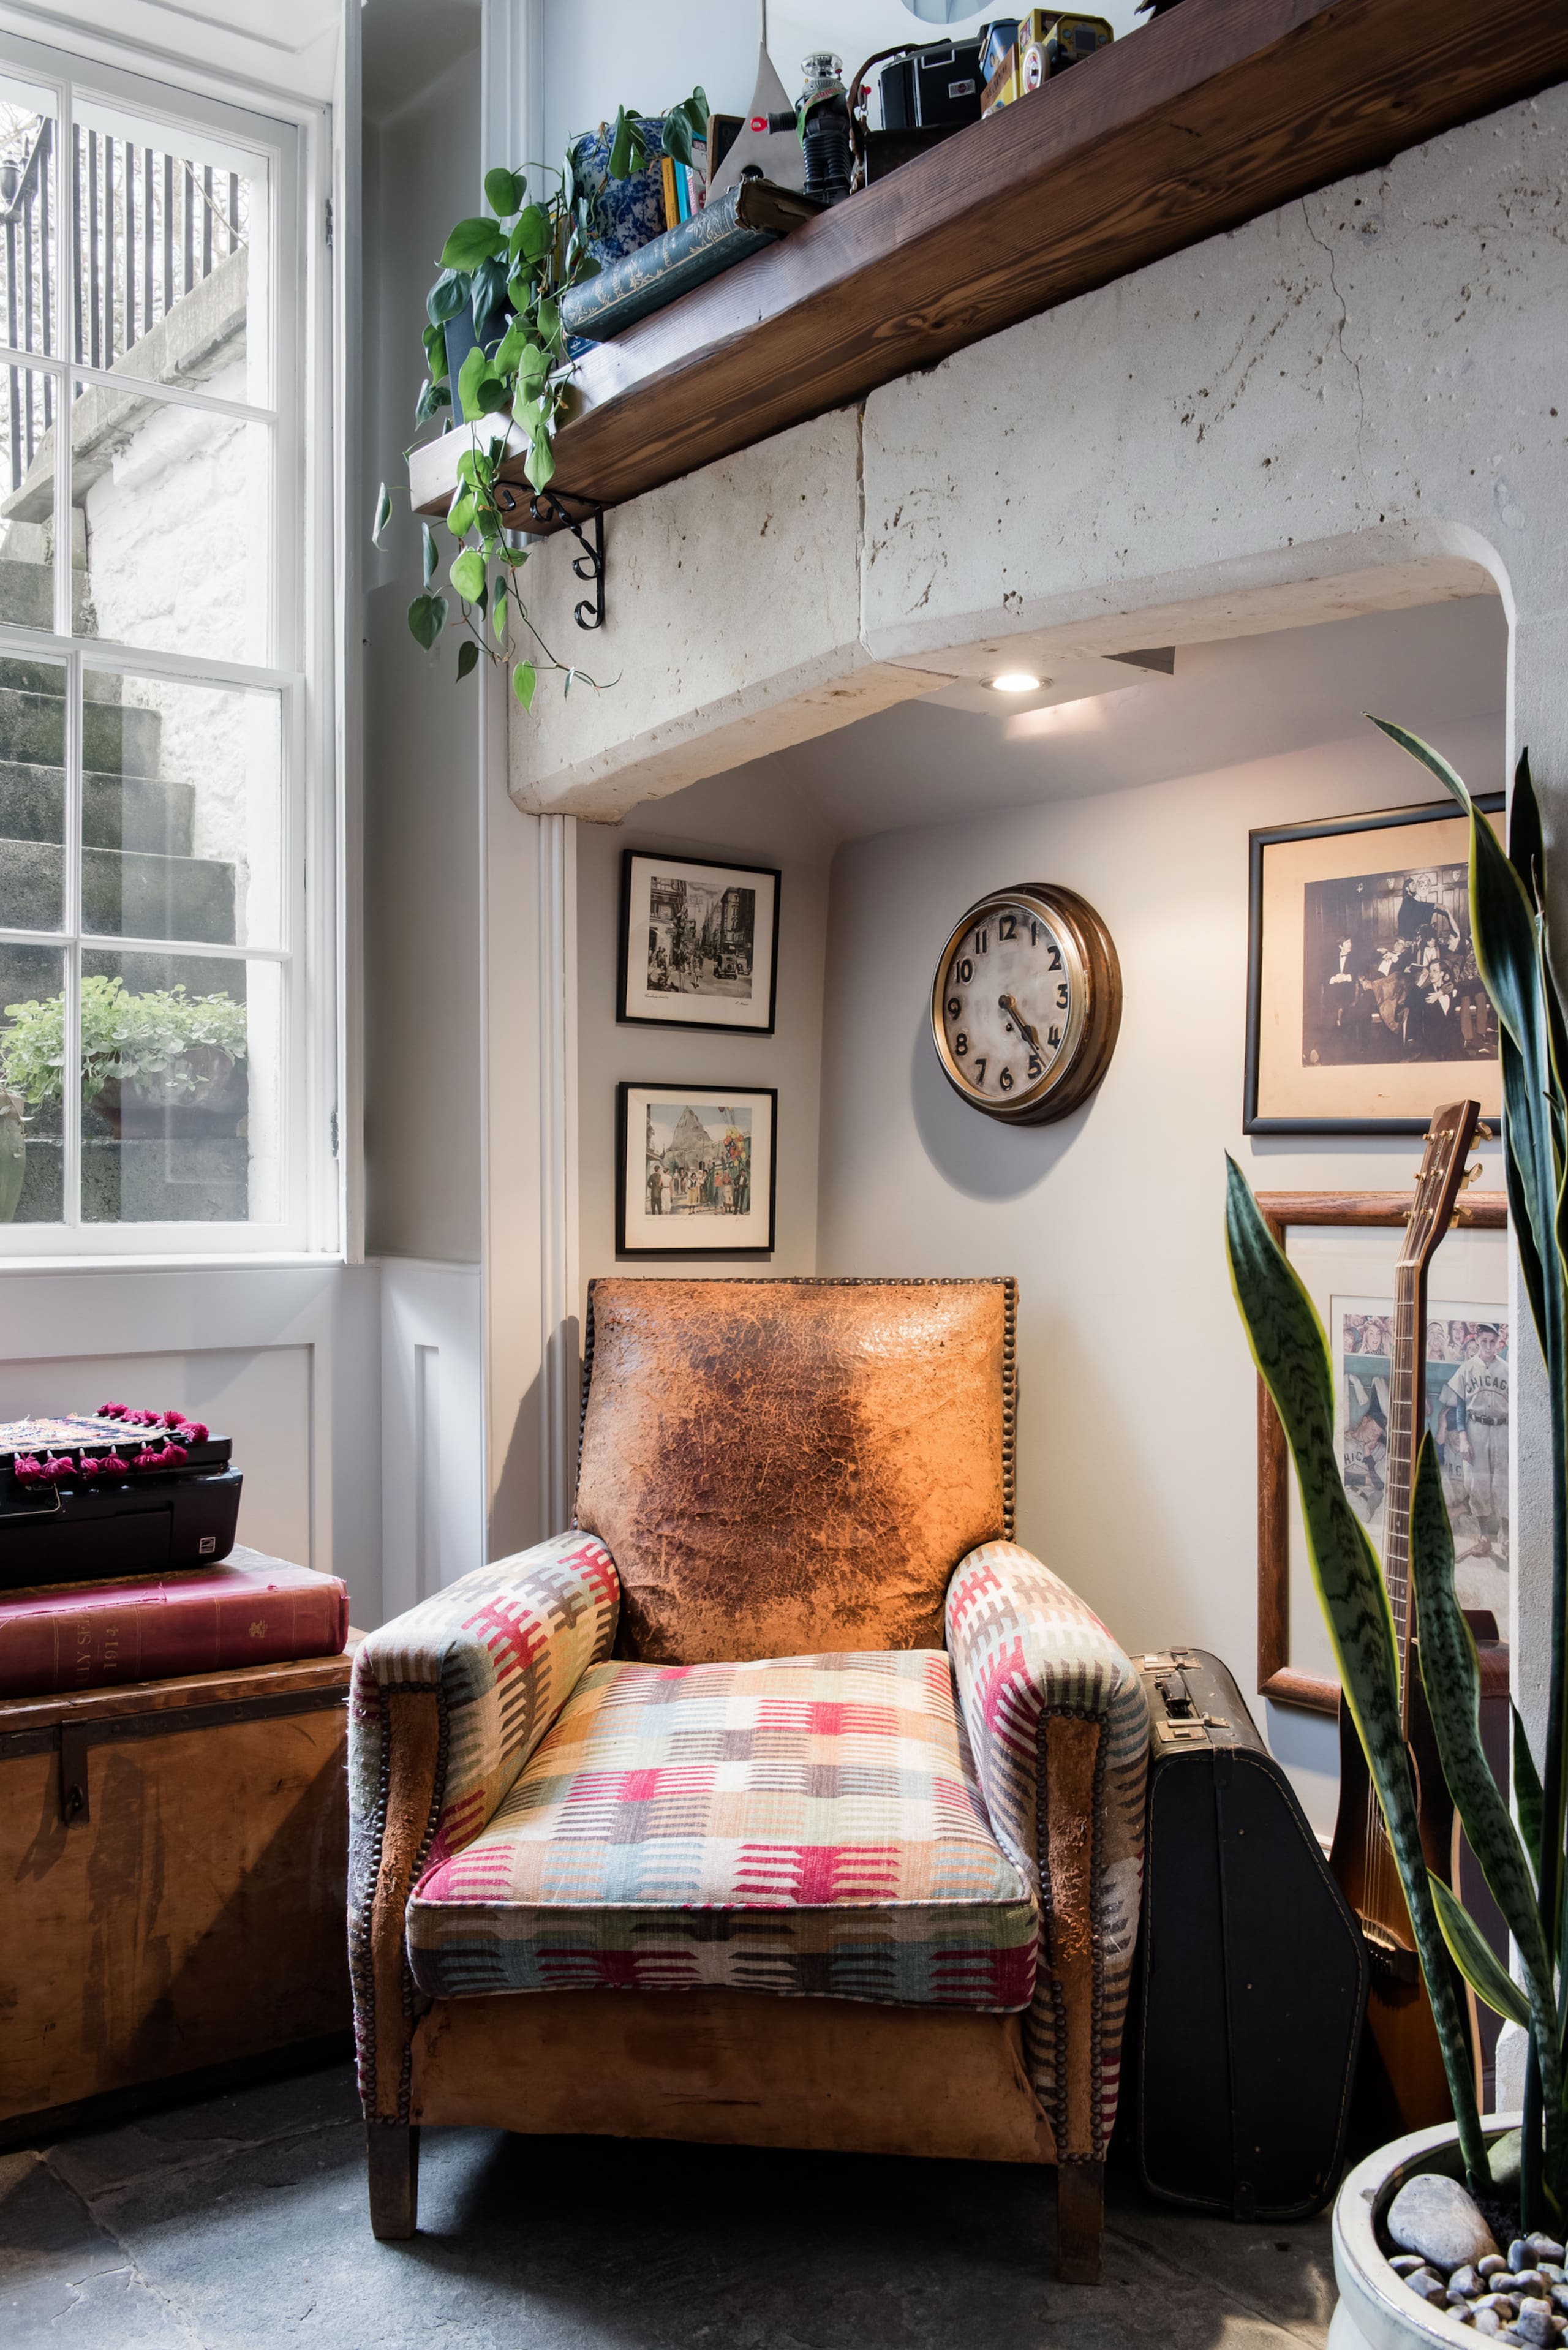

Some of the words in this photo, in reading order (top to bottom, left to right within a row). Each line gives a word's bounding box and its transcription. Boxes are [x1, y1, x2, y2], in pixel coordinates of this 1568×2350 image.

[976, 928, 987, 954] 11
[999, 916, 1017, 941] 12
[1031, 921, 1036, 946] 1
[956, 959, 973, 983] 10
[1048, 946, 1062, 971] 2
[948, 998, 961, 1020] 9
[1056, 984, 1068, 1009] 3
[956, 1033, 968, 1056] 8
[1047, 1025, 1061, 1049] 4
[975, 1058, 987, 1082] 7
[1000, 1066, 1014, 1091] 6
[1027, 1054, 1041, 1079] 5
[103, 1627, 118, 1670] 1914
